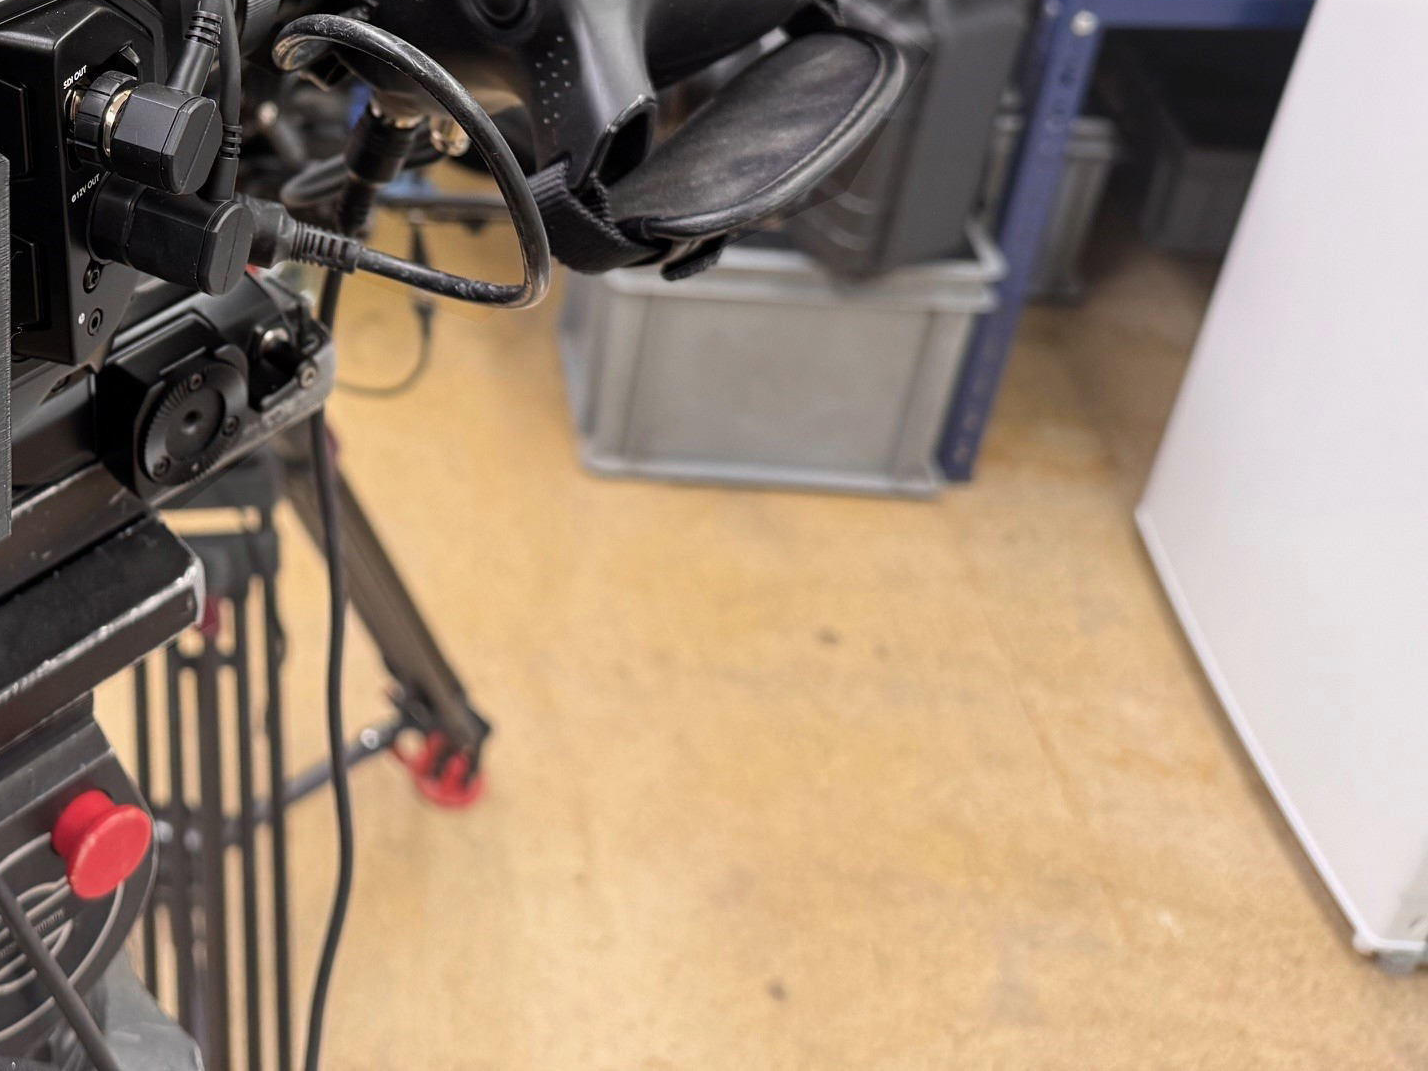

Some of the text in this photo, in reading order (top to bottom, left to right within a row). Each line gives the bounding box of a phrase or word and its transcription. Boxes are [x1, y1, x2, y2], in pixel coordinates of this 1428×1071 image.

[63, 65, 87, 90] SDI OUT
[87, 173, 100, 189] OUT
